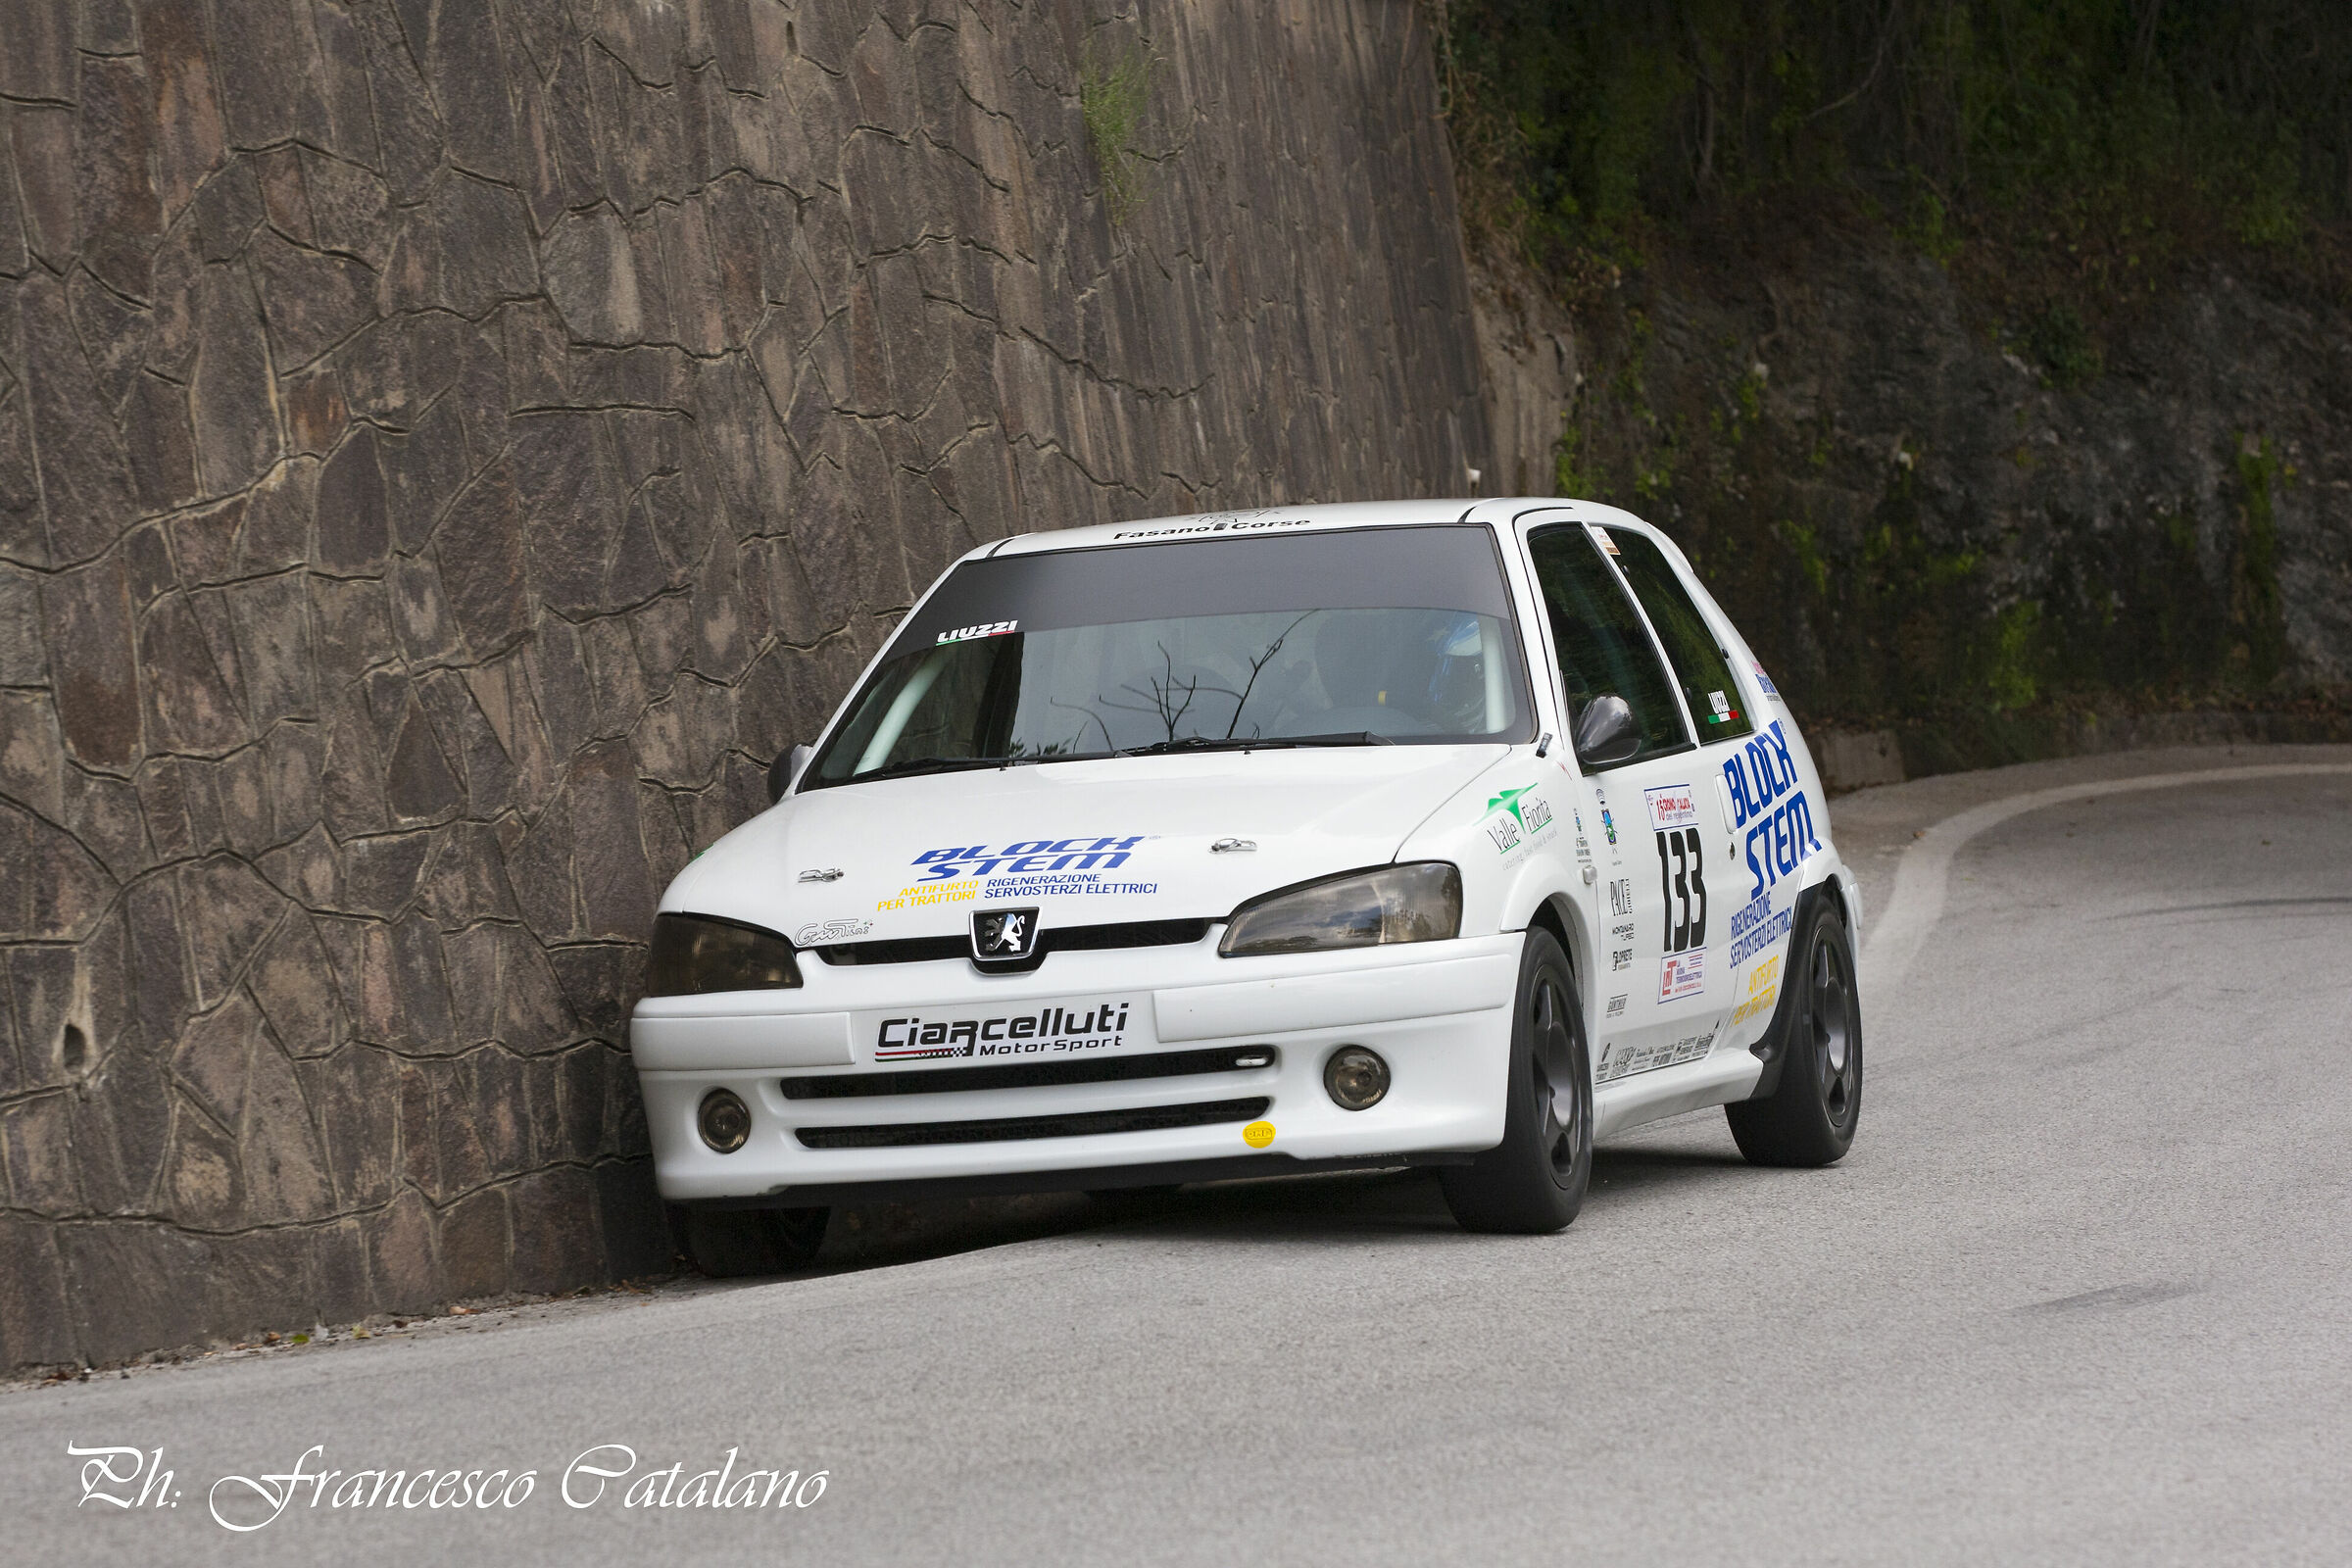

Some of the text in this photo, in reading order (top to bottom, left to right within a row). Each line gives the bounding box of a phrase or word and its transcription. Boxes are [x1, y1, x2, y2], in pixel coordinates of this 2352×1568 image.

[1113, 519, 1311, 540] Fasano Corse
[937, 619, 1019, 643] LIUZZI
[1723, 719, 1798, 829] BLOCK
[1487, 797, 1551, 852] Valle Fiorita
[910, 836, 1145, 865] BLOCK
[1746, 790, 1823, 902] STEM
[916, 852, 1132, 882] STEM
[987, 873, 1102, 888] RIGENERAZIONE
[877, 890, 976, 912] PER TRATTORI
[899, 880, 978, 897] ANTIFURTO
[984, 883, 1158, 899] SERVOSTERZI ELETTRICI
[1656, 828, 1707, 953] 133
[1731, 891, 1772, 940] RIGENERAZIONE
[1730, 923, 1766, 969] SERVOSTERZI
[1748, 955, 1779, 996] ANTIFURTO
[1730, 984, 1776, 1027] PER TRATTORI
[980, 1035, 1123, 1055] MotorSport
